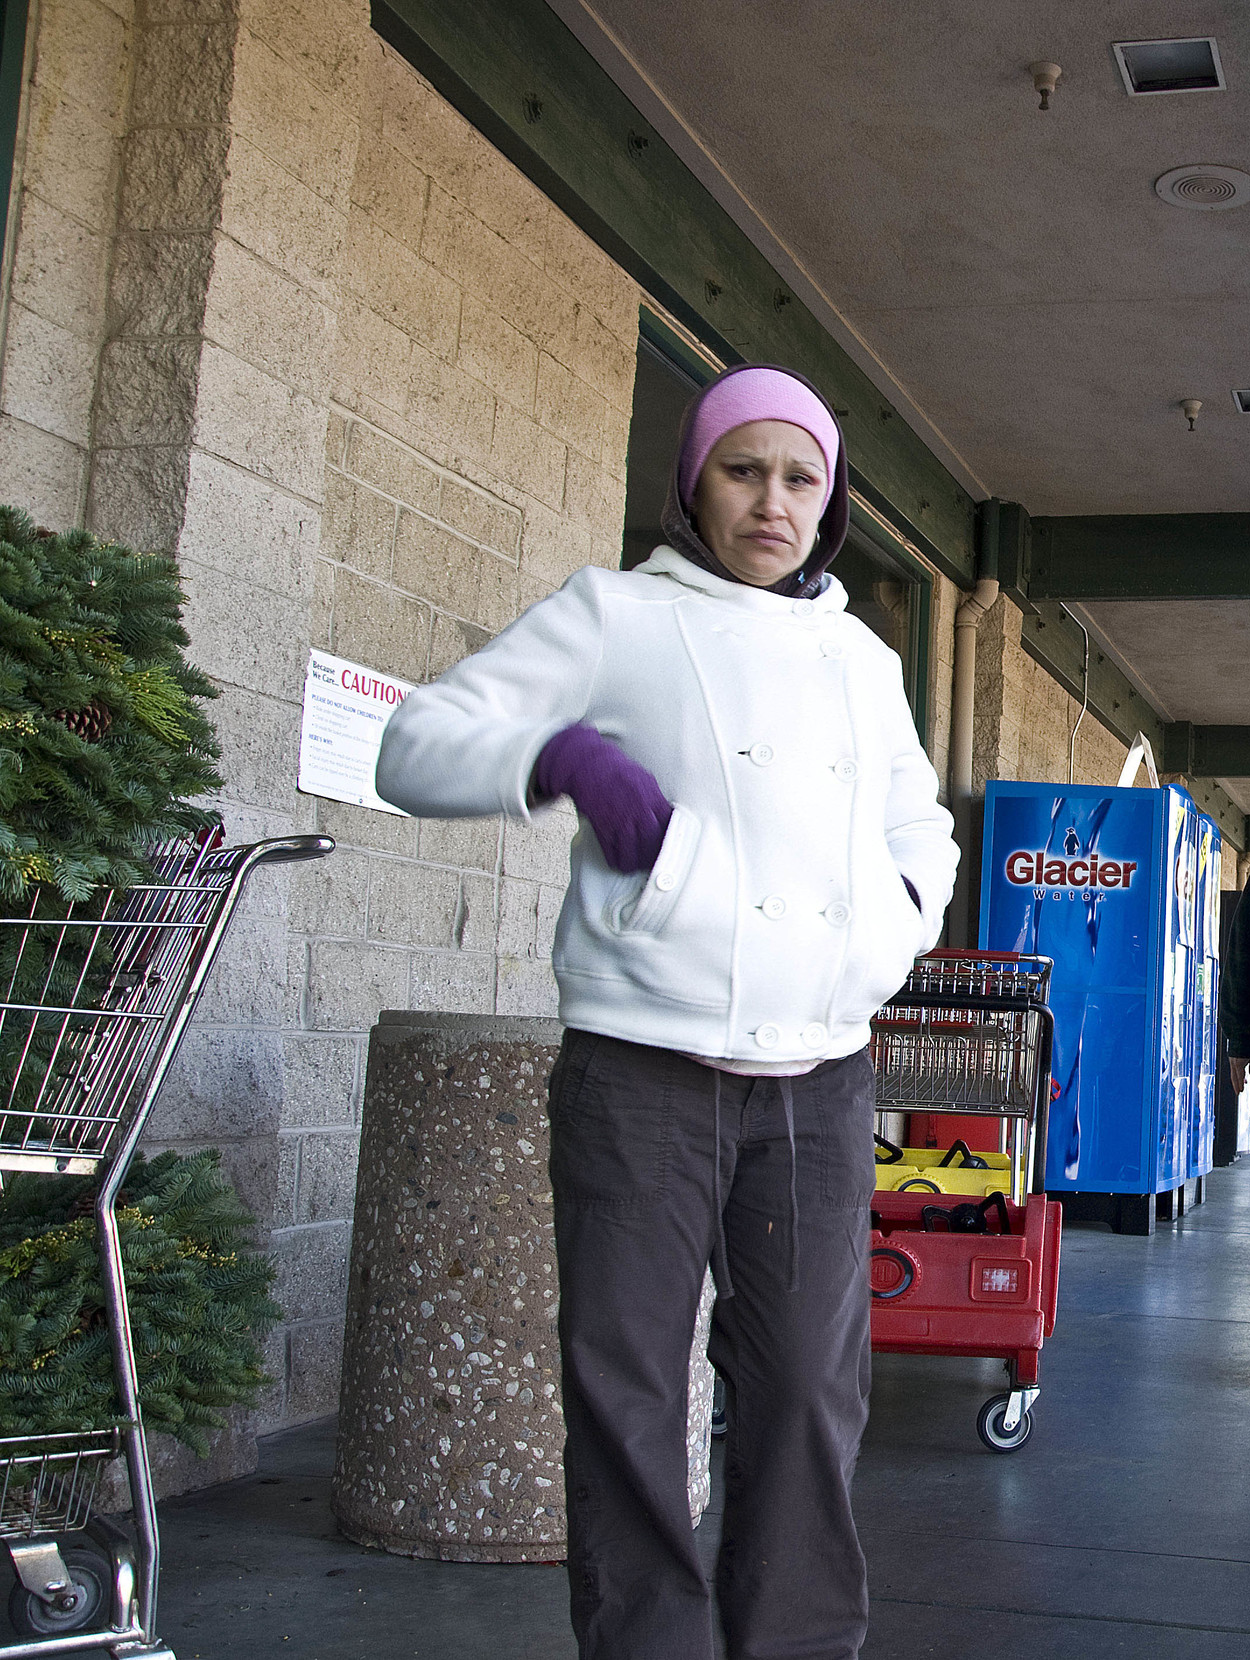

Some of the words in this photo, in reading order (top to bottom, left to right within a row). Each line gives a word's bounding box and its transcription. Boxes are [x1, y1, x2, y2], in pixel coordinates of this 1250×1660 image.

[312, 660, 336, 676] Because
[312, 671, 322, 680] We
[311, 693, 326, 704] PLEASE
[326, 698, 334, 706] DO
[334, 700, 342, 709] NOT
[343, 703, 356, 714] ALLOW
[357, 707, 377, 721] CHILDREN
[1006, 851, 1137, 888] Glacier
[1033, 889, 1105, 901] Water
